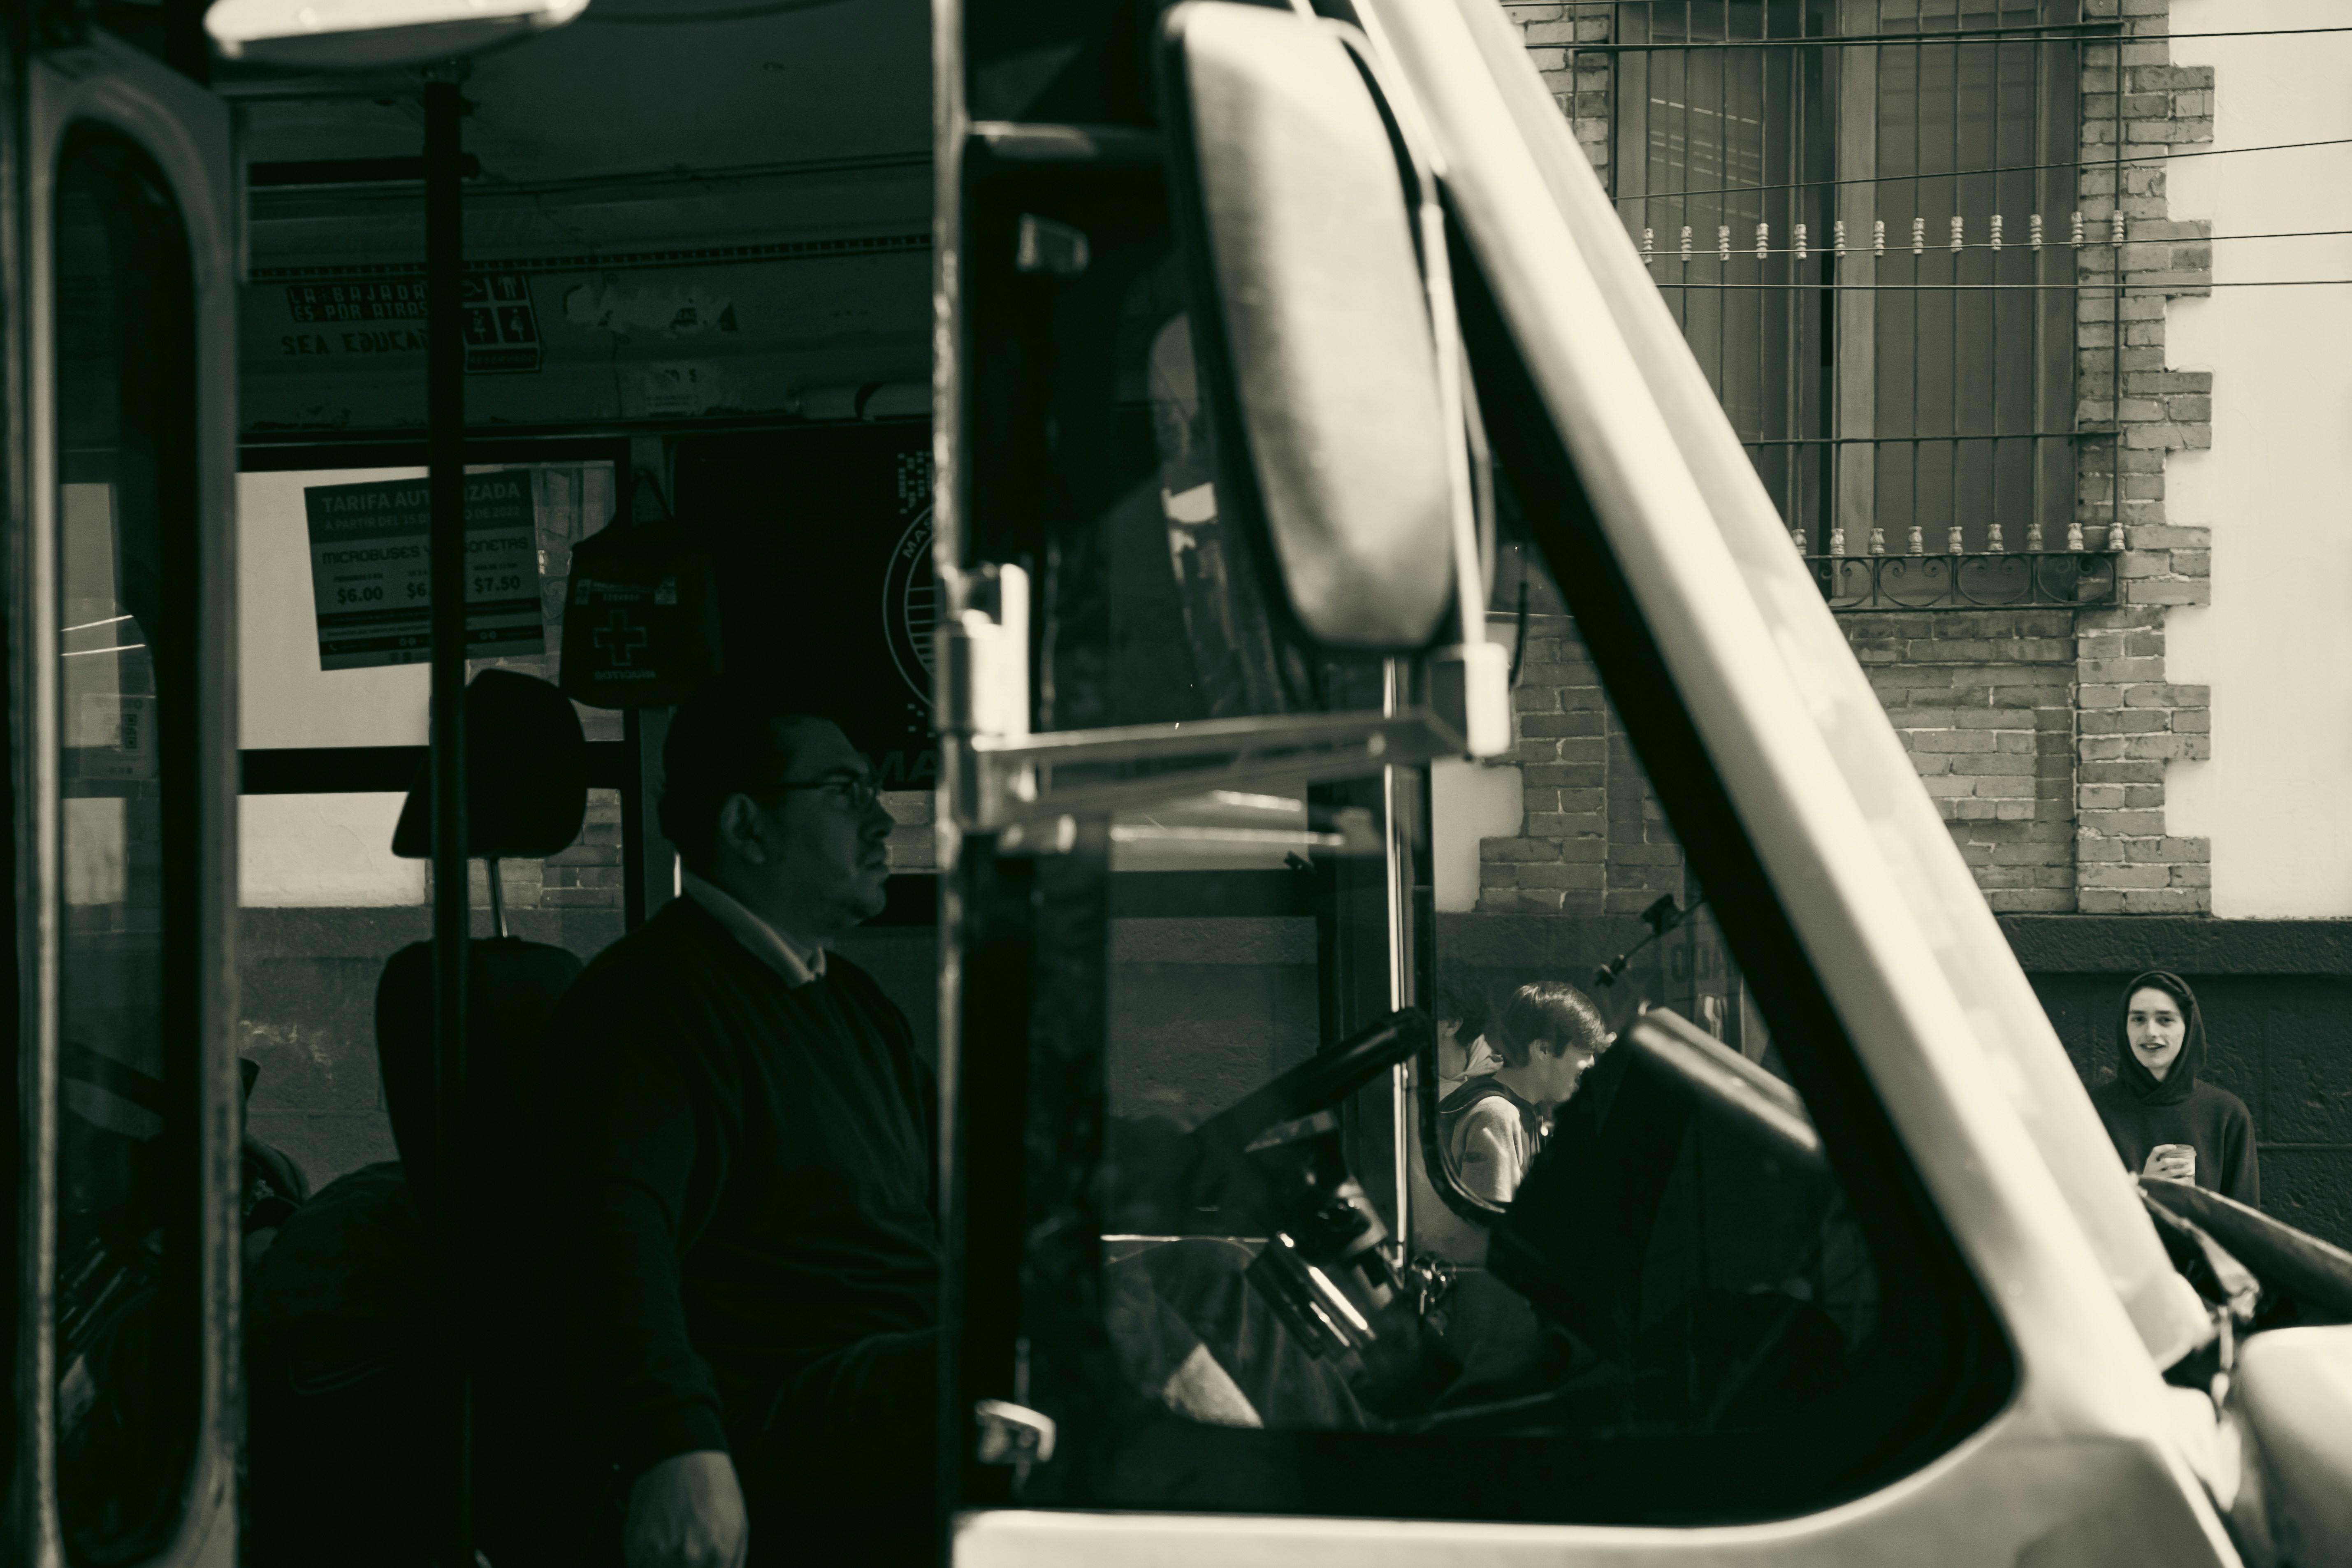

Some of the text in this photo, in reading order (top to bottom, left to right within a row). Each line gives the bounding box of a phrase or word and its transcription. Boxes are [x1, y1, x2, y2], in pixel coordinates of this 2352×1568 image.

[290, 284, 425, 304] LA BAJADA
[294, 301, 428, 321] ES POR ATRAS
[281, 334, 330, 355] SEA
[321, 492, 390, 513] TARIFA
[325, 520, 334, 530] A
[335, 517, 376, 529] PARTIR
[378, 515, 399, 527] DEL
[322, 545, 420, 565] MICROBUSES
[474, 574, 521, 595] $7.50
[337, 586, 383, 605] $6.00
